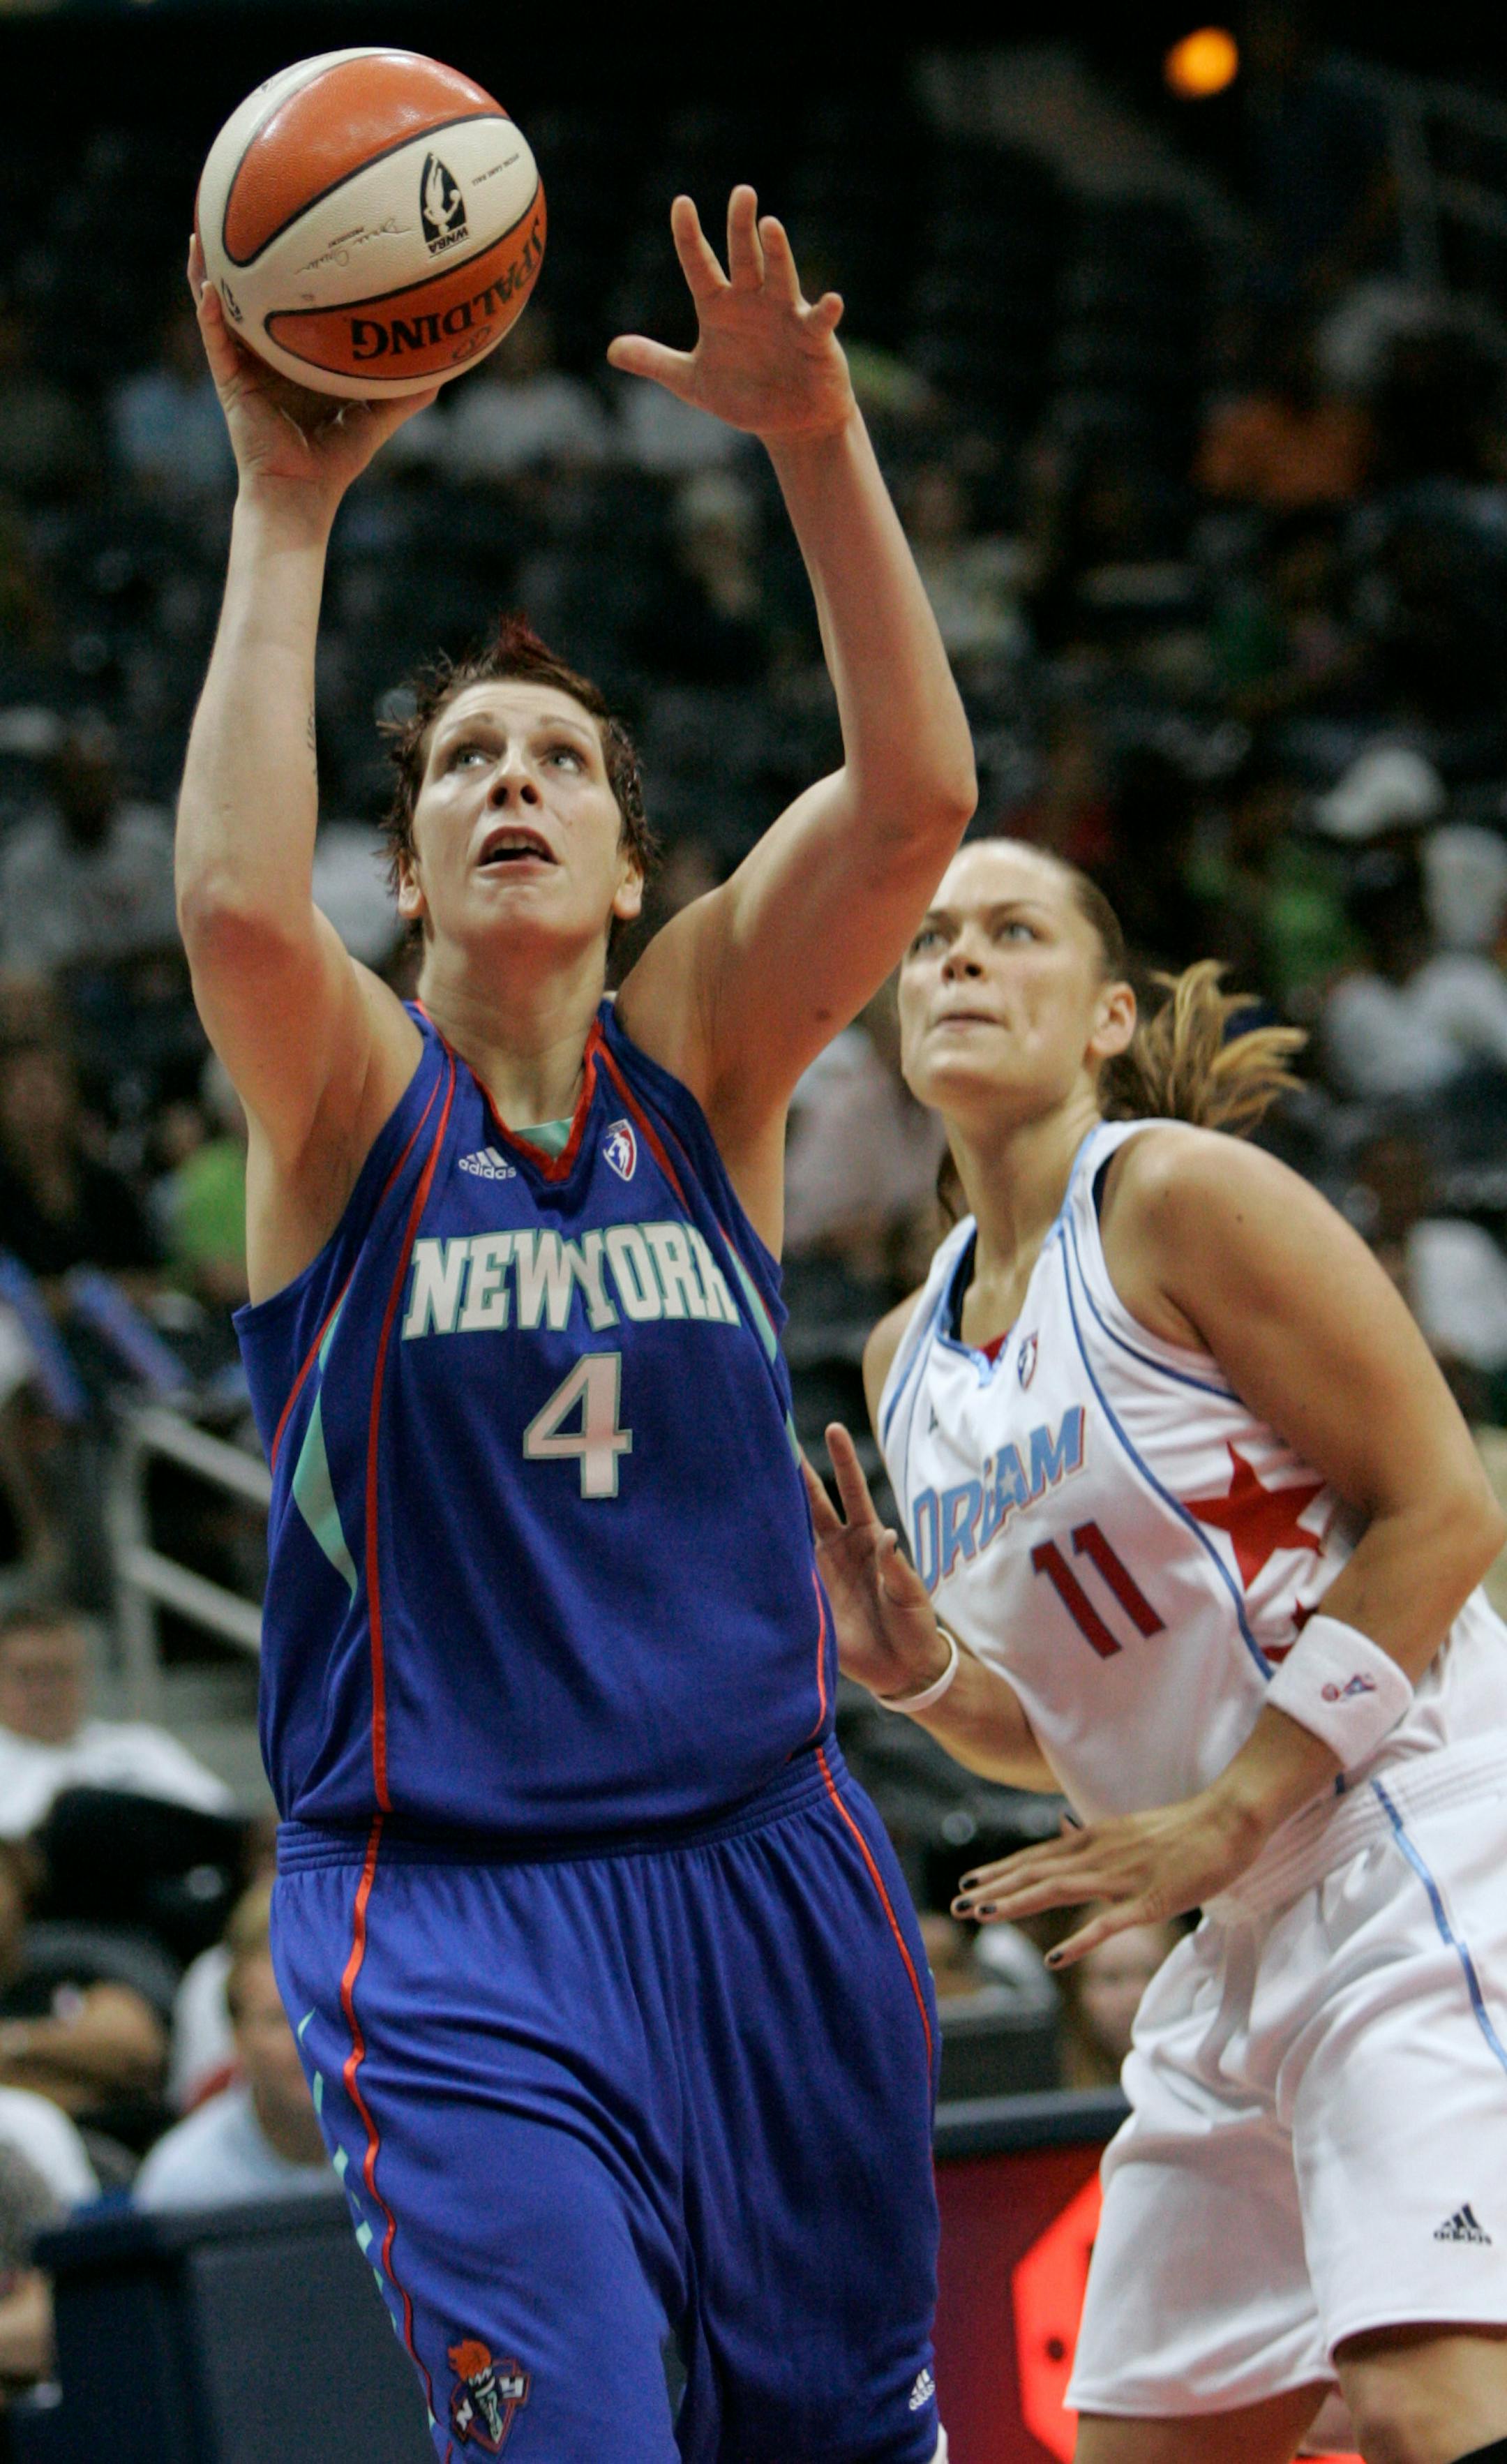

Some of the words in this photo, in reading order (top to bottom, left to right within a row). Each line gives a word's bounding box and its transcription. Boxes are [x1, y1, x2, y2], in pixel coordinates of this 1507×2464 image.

[428, 225, 469, 254] WNBA
[458, 1158, 517, 1181] adidas
[523, 1352, 632, 1499] 4
[1030, 1520, 1167, 1659] 11
[1432, 2227, 1492, 2246] adidas
